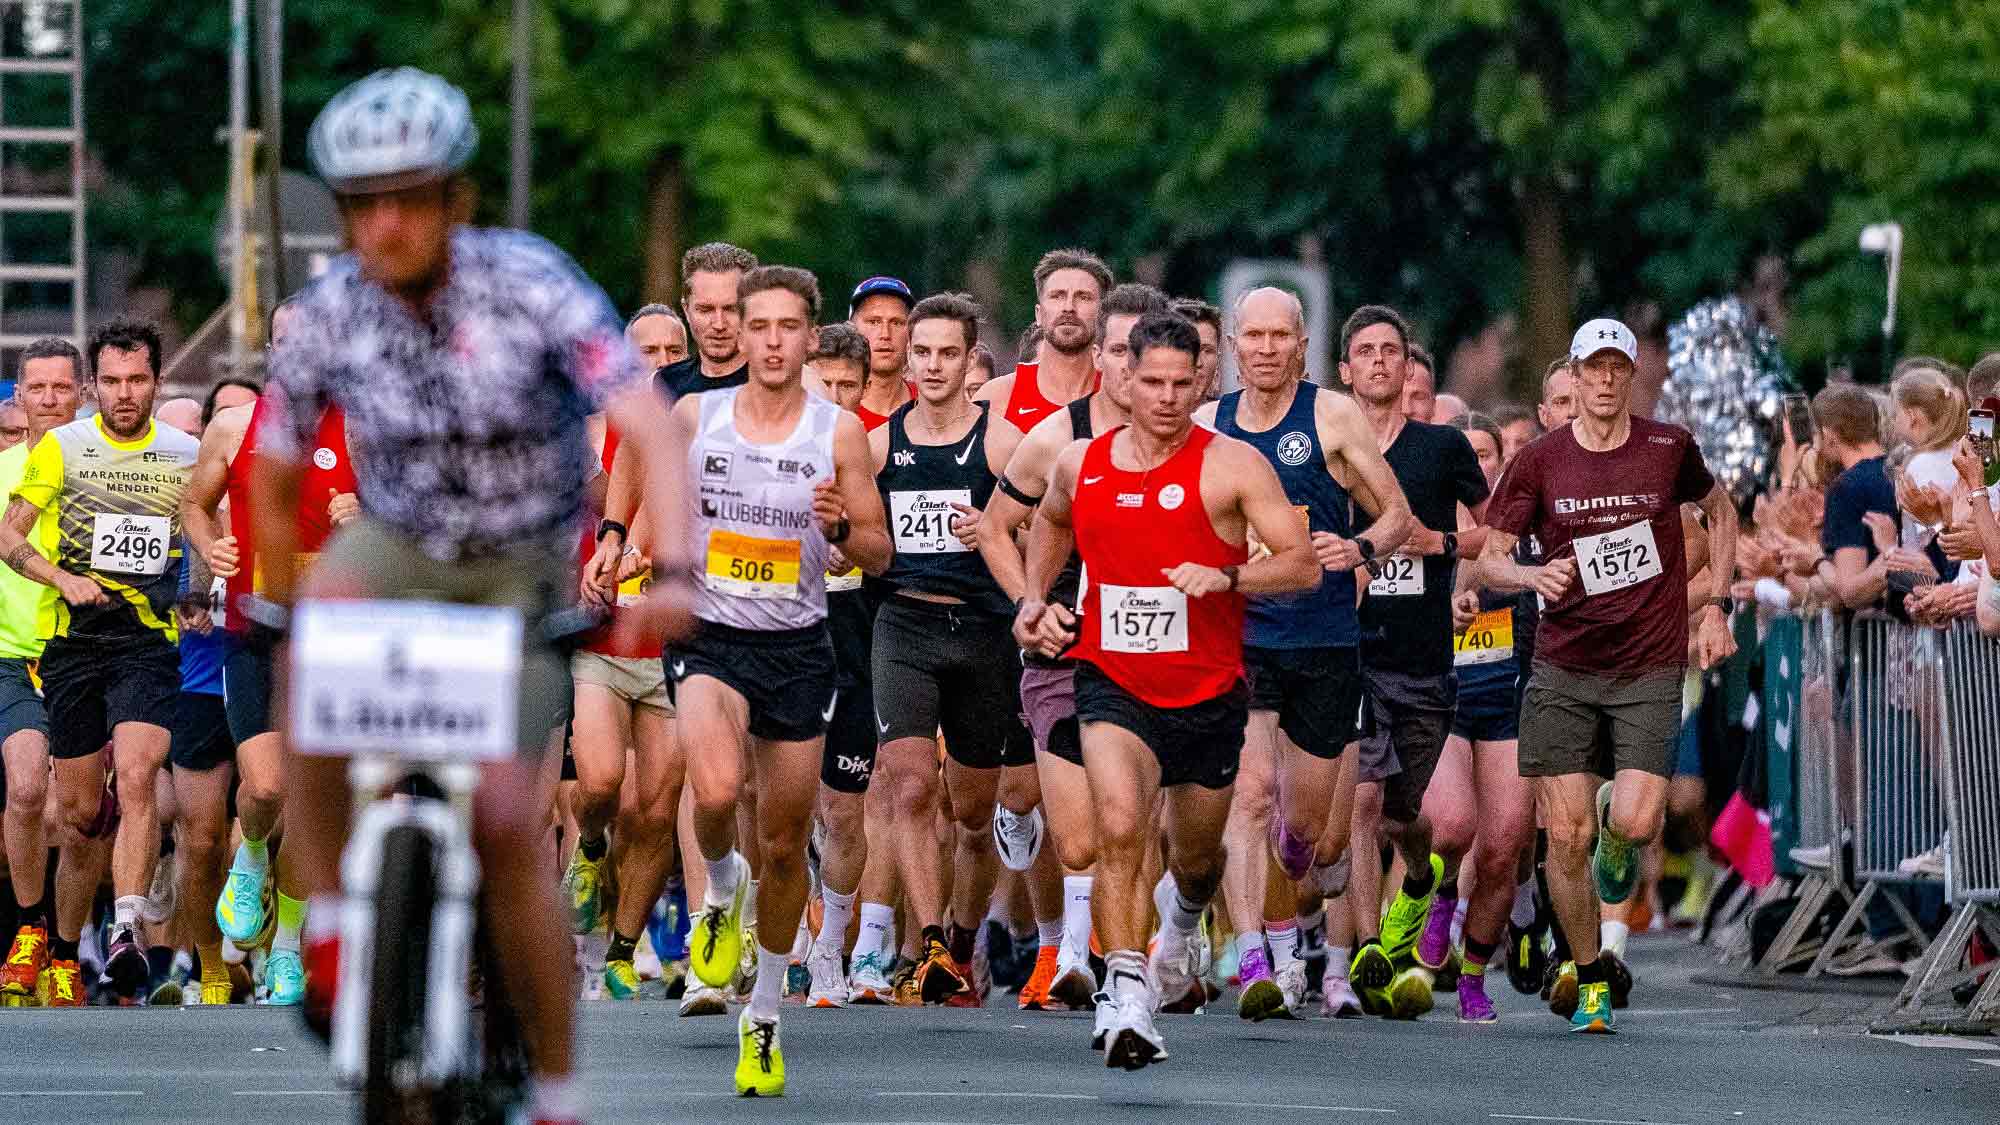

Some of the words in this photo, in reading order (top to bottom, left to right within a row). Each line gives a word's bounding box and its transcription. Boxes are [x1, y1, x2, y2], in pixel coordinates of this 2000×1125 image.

[80, 470, 182, 485] MARATHON-CLUB
[106, 483, 159, 493] MENDEN
[100, 534, 161, 560] 2496
[730, 558, 774, 581] 506
[1587, 544, 1650, 580] 1572
[1109, 610, 1176, 637] 1577
